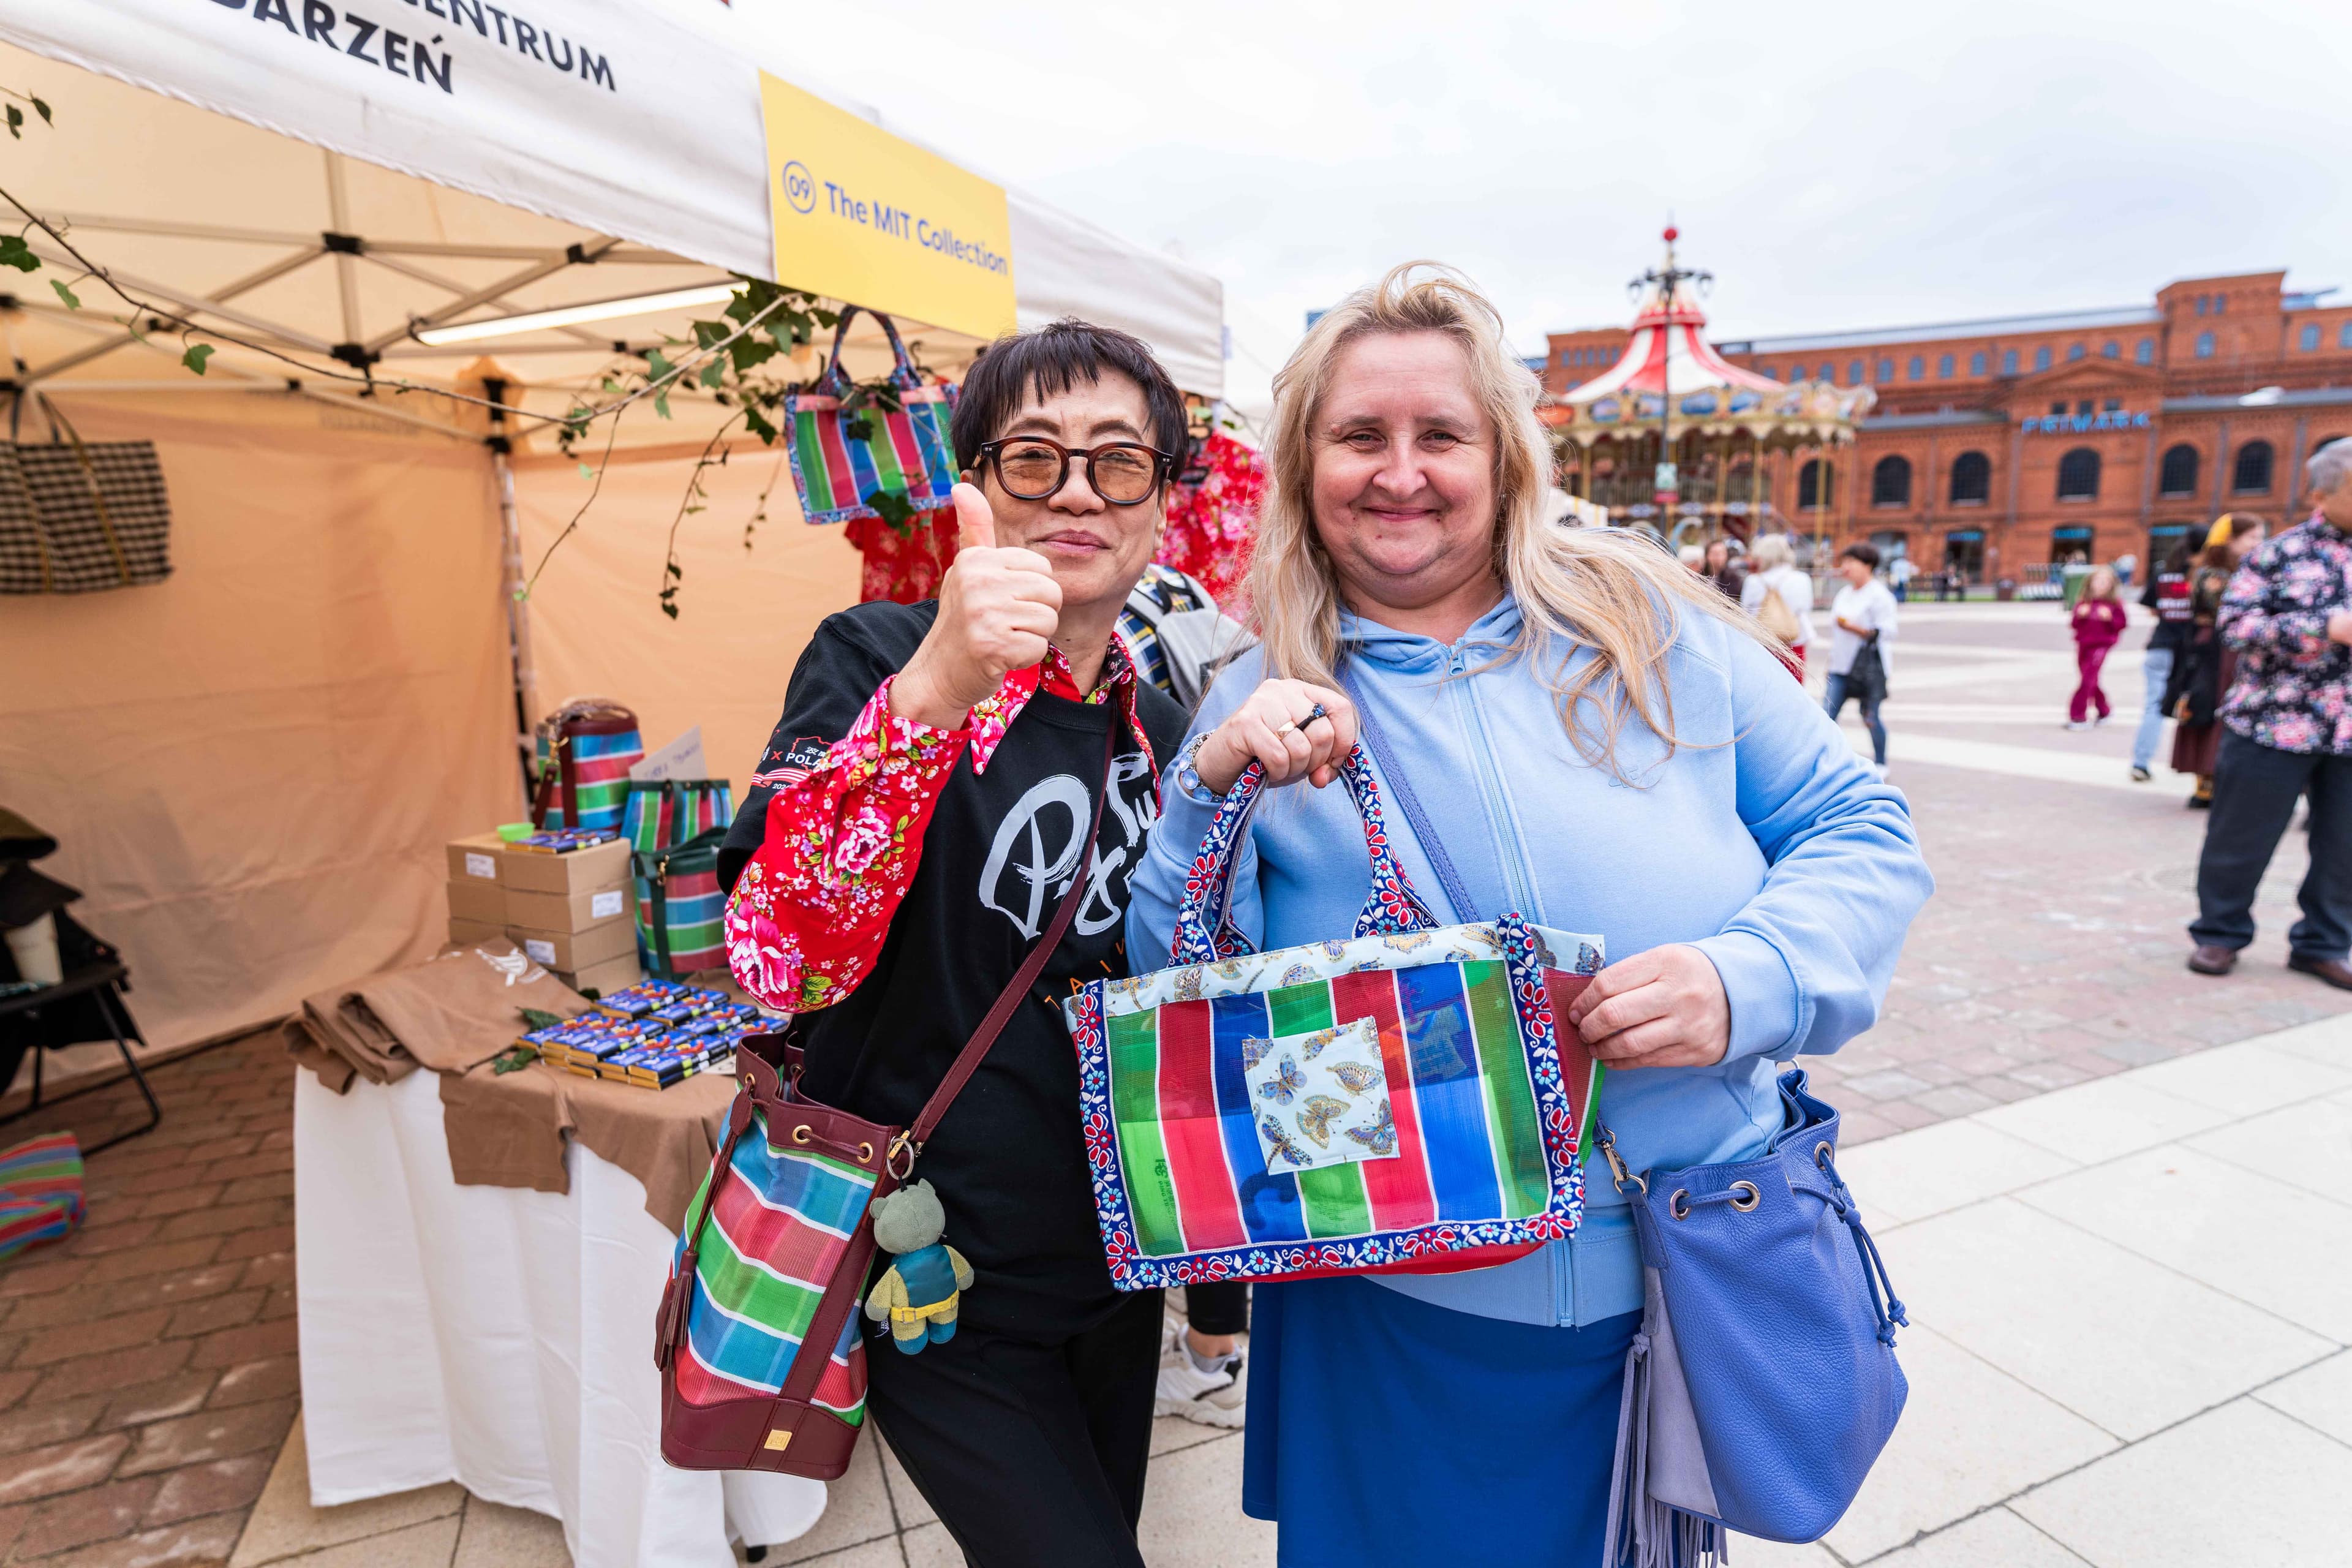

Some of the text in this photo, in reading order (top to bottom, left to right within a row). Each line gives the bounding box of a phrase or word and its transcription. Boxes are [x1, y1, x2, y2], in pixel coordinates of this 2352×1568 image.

[210, 0, 453, 94] ARZEŃ
[403, 0, 616, 92] NTRUM
[789, 175, 1008, 276] 09 The MIT Collection
[2021, 409, 2152, 433] PRIMARK
